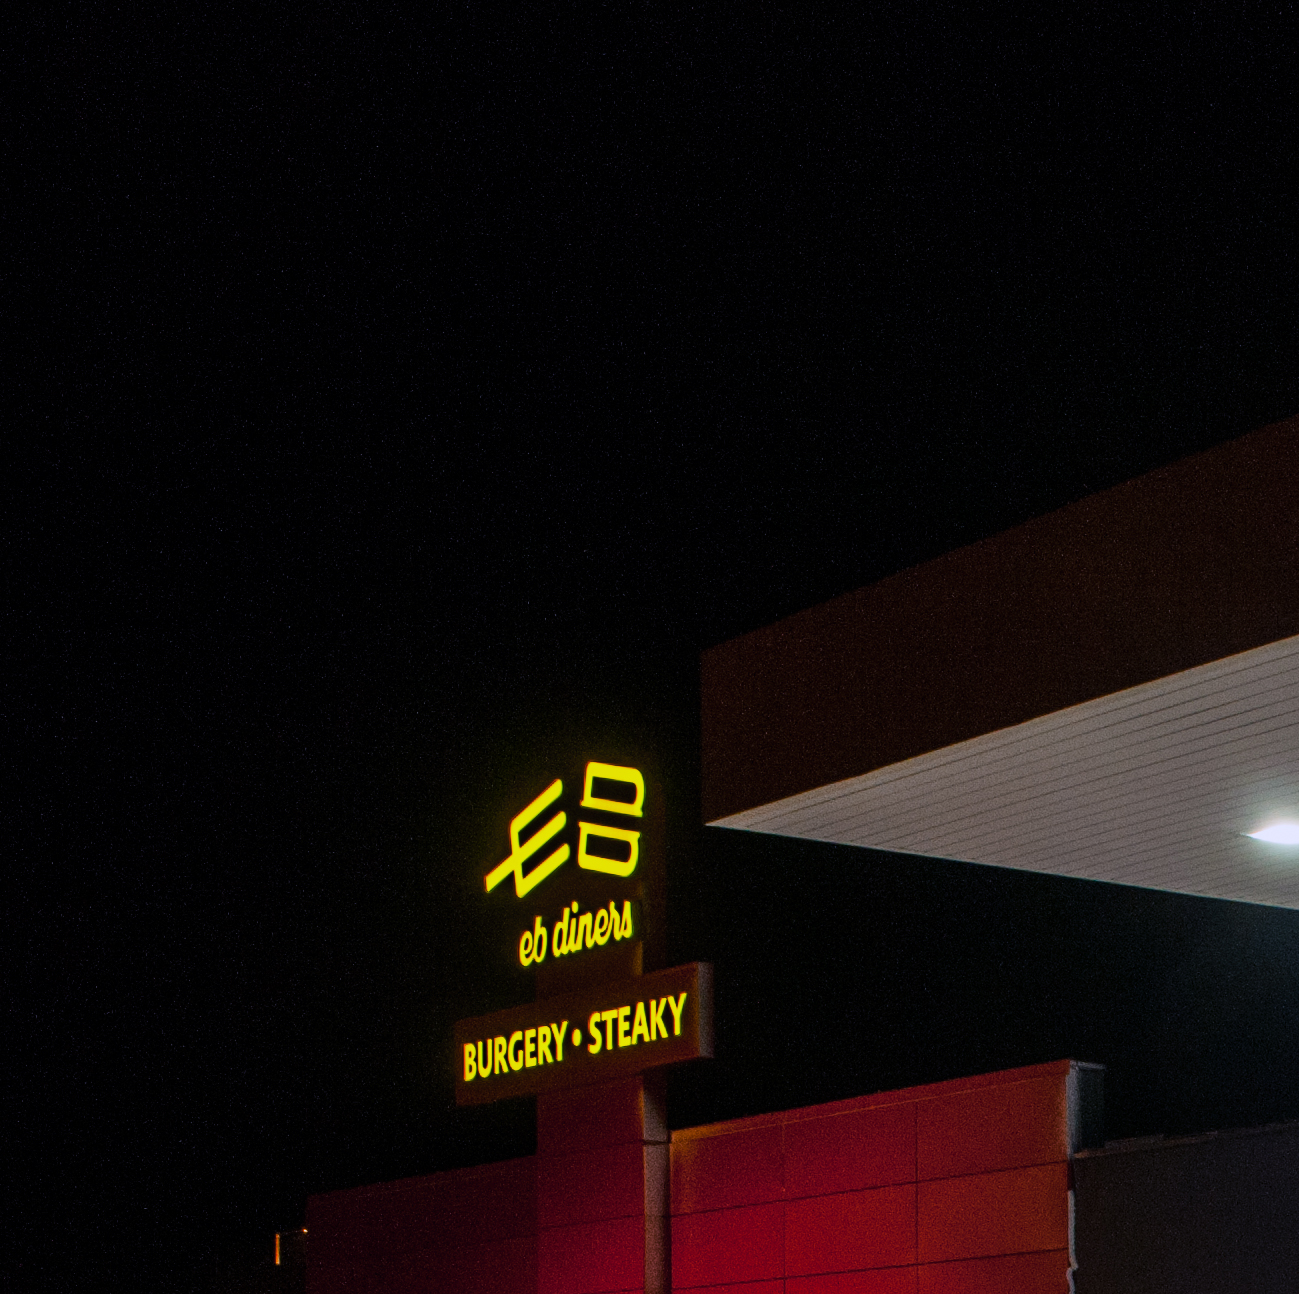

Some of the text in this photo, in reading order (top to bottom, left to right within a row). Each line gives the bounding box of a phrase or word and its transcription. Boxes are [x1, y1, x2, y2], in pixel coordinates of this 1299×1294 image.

[518, 900, 634, 967] eb diners
[463, 992, 687, 1082] BURGERY STEAKY
